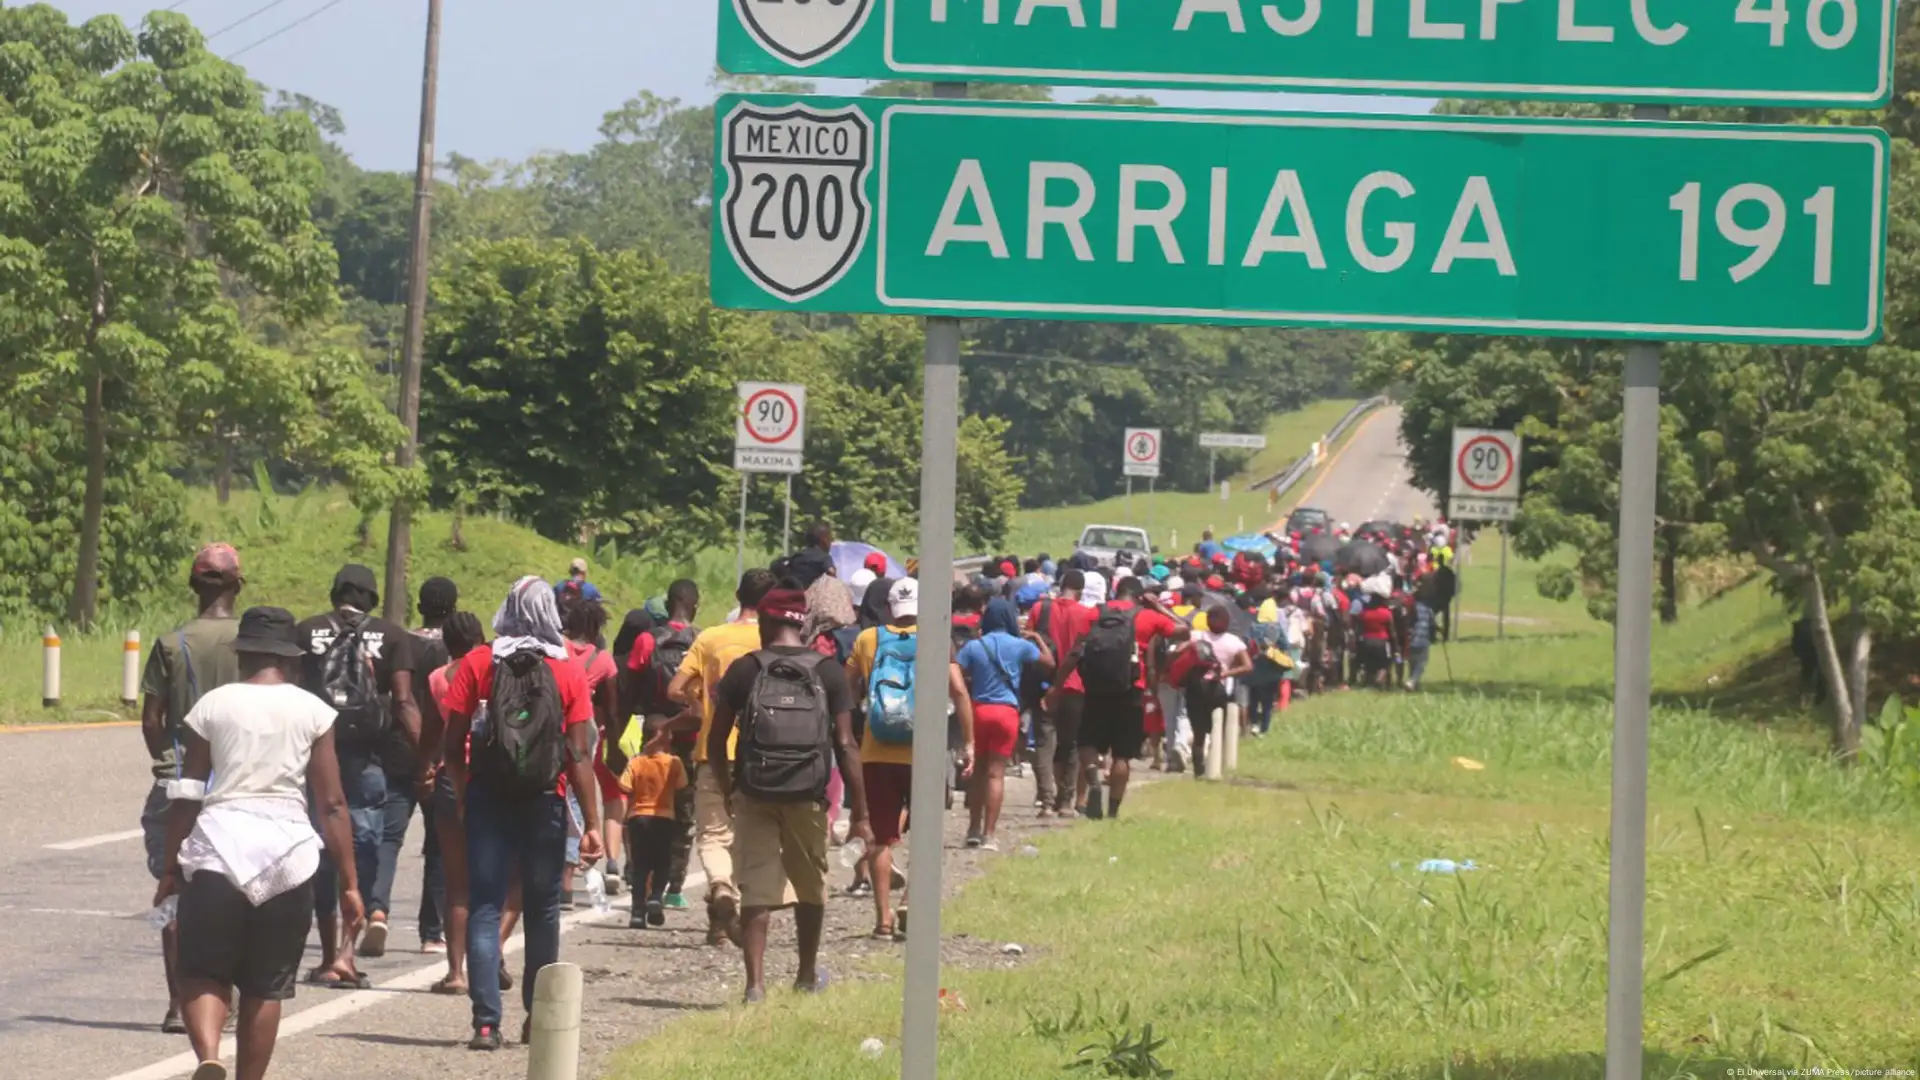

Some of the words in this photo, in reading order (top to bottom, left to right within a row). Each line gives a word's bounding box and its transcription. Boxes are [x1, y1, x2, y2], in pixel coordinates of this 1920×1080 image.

[747, 124, 848, 155] MEXICO
[750, 173, 843, 241] 200
[925, 159, 1517, 277] ARRIAGA
[1669, 182, 1835, 285] 191
[758, 400, 784, 423] 90
[1472, 447, 1499, 471] 90
